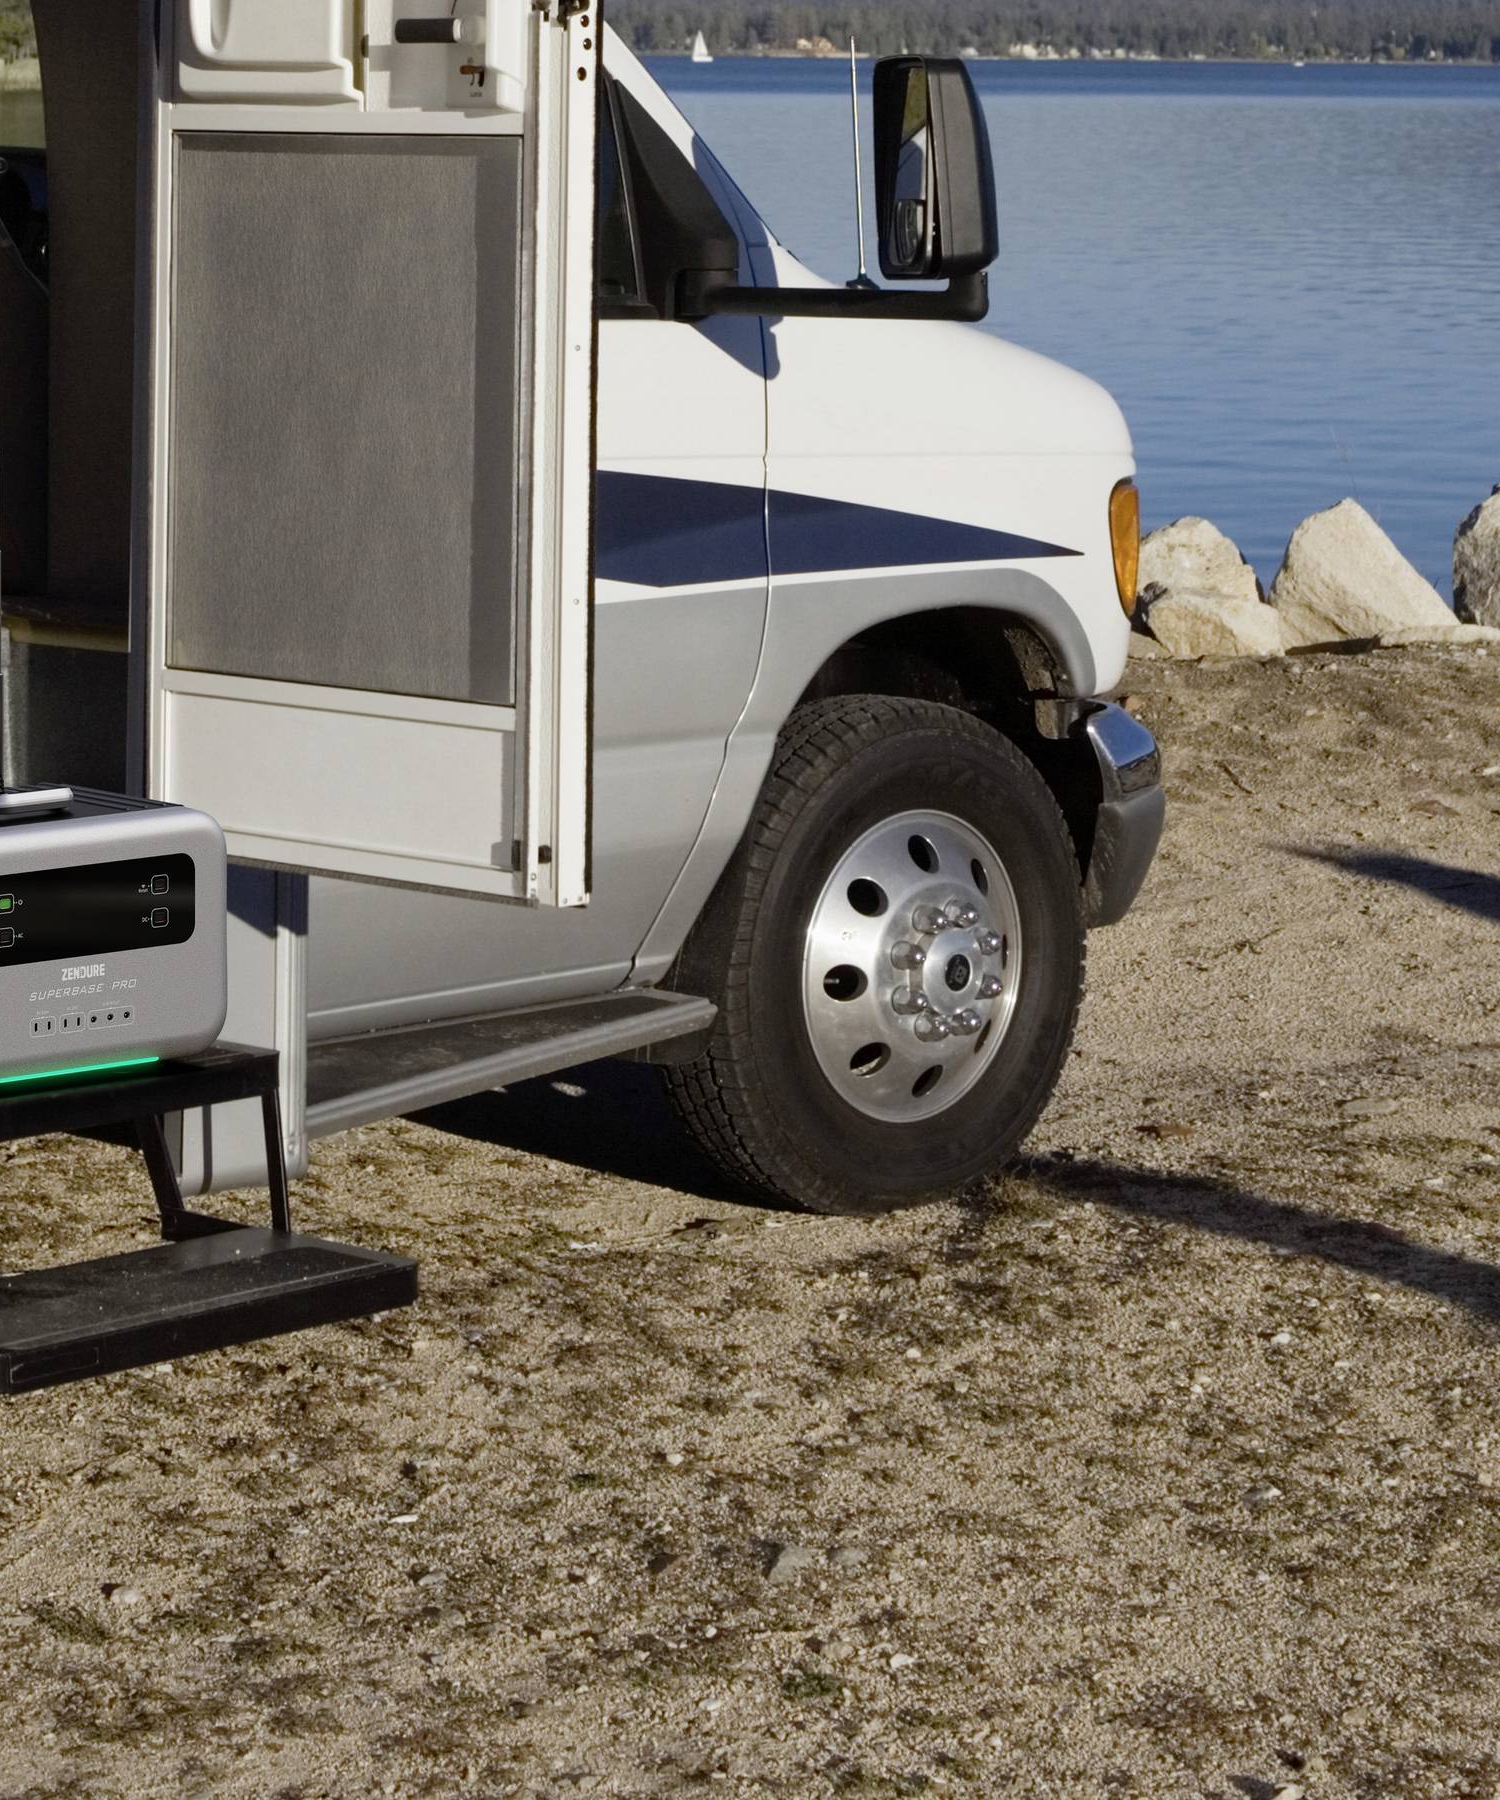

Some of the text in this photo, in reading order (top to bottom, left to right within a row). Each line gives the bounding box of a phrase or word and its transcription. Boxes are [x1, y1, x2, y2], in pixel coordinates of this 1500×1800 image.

[61, 963, 106, 981] ZENDURE
[29, 978, 137, 1001] SUPERBASE PRO
